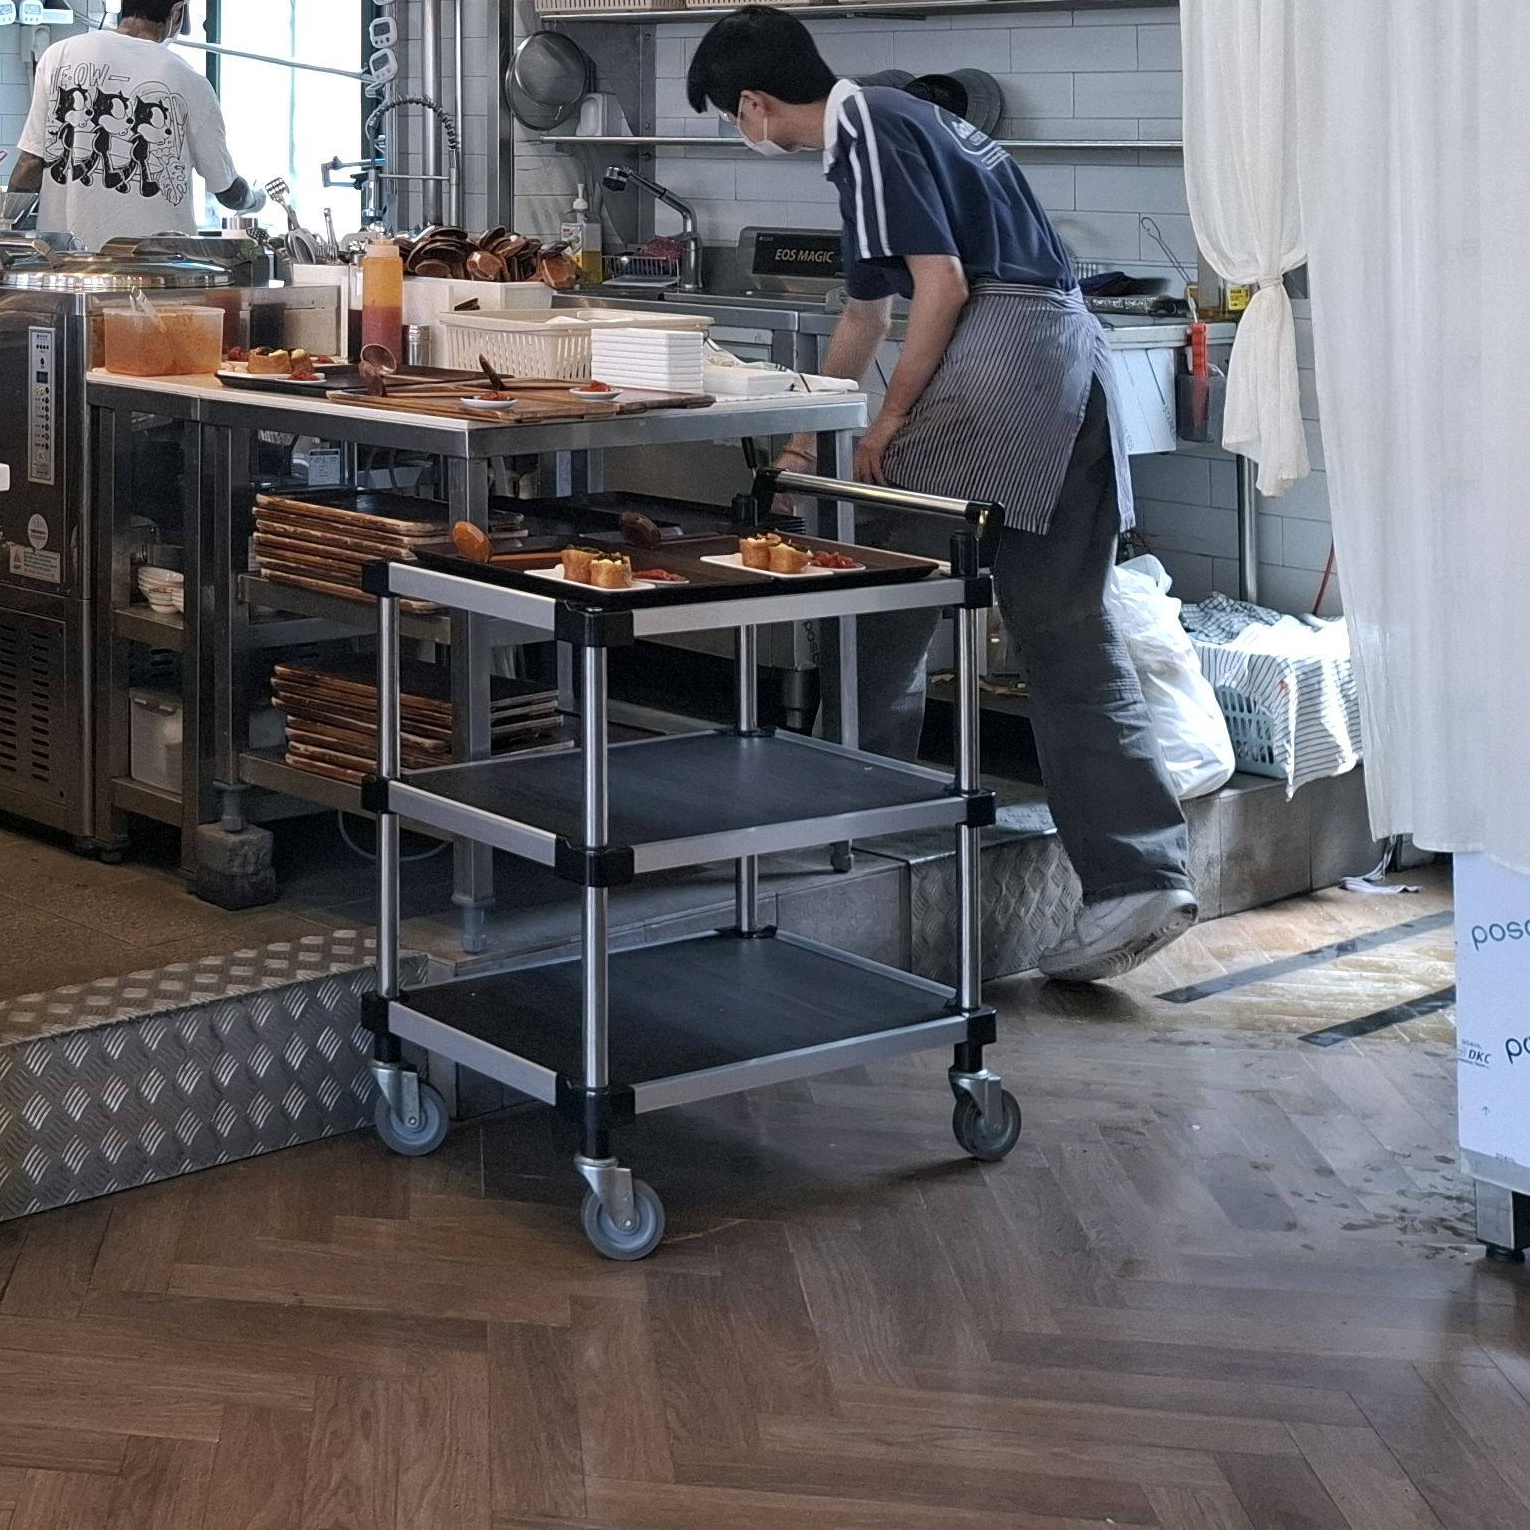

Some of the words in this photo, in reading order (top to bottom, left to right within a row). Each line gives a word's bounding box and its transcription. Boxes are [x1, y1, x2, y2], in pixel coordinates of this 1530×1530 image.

[774, 249, 796, 261] EOS
[797, 250, 835, 263] MAGIC
[1468, 1048, 1492, 1064] DKC
